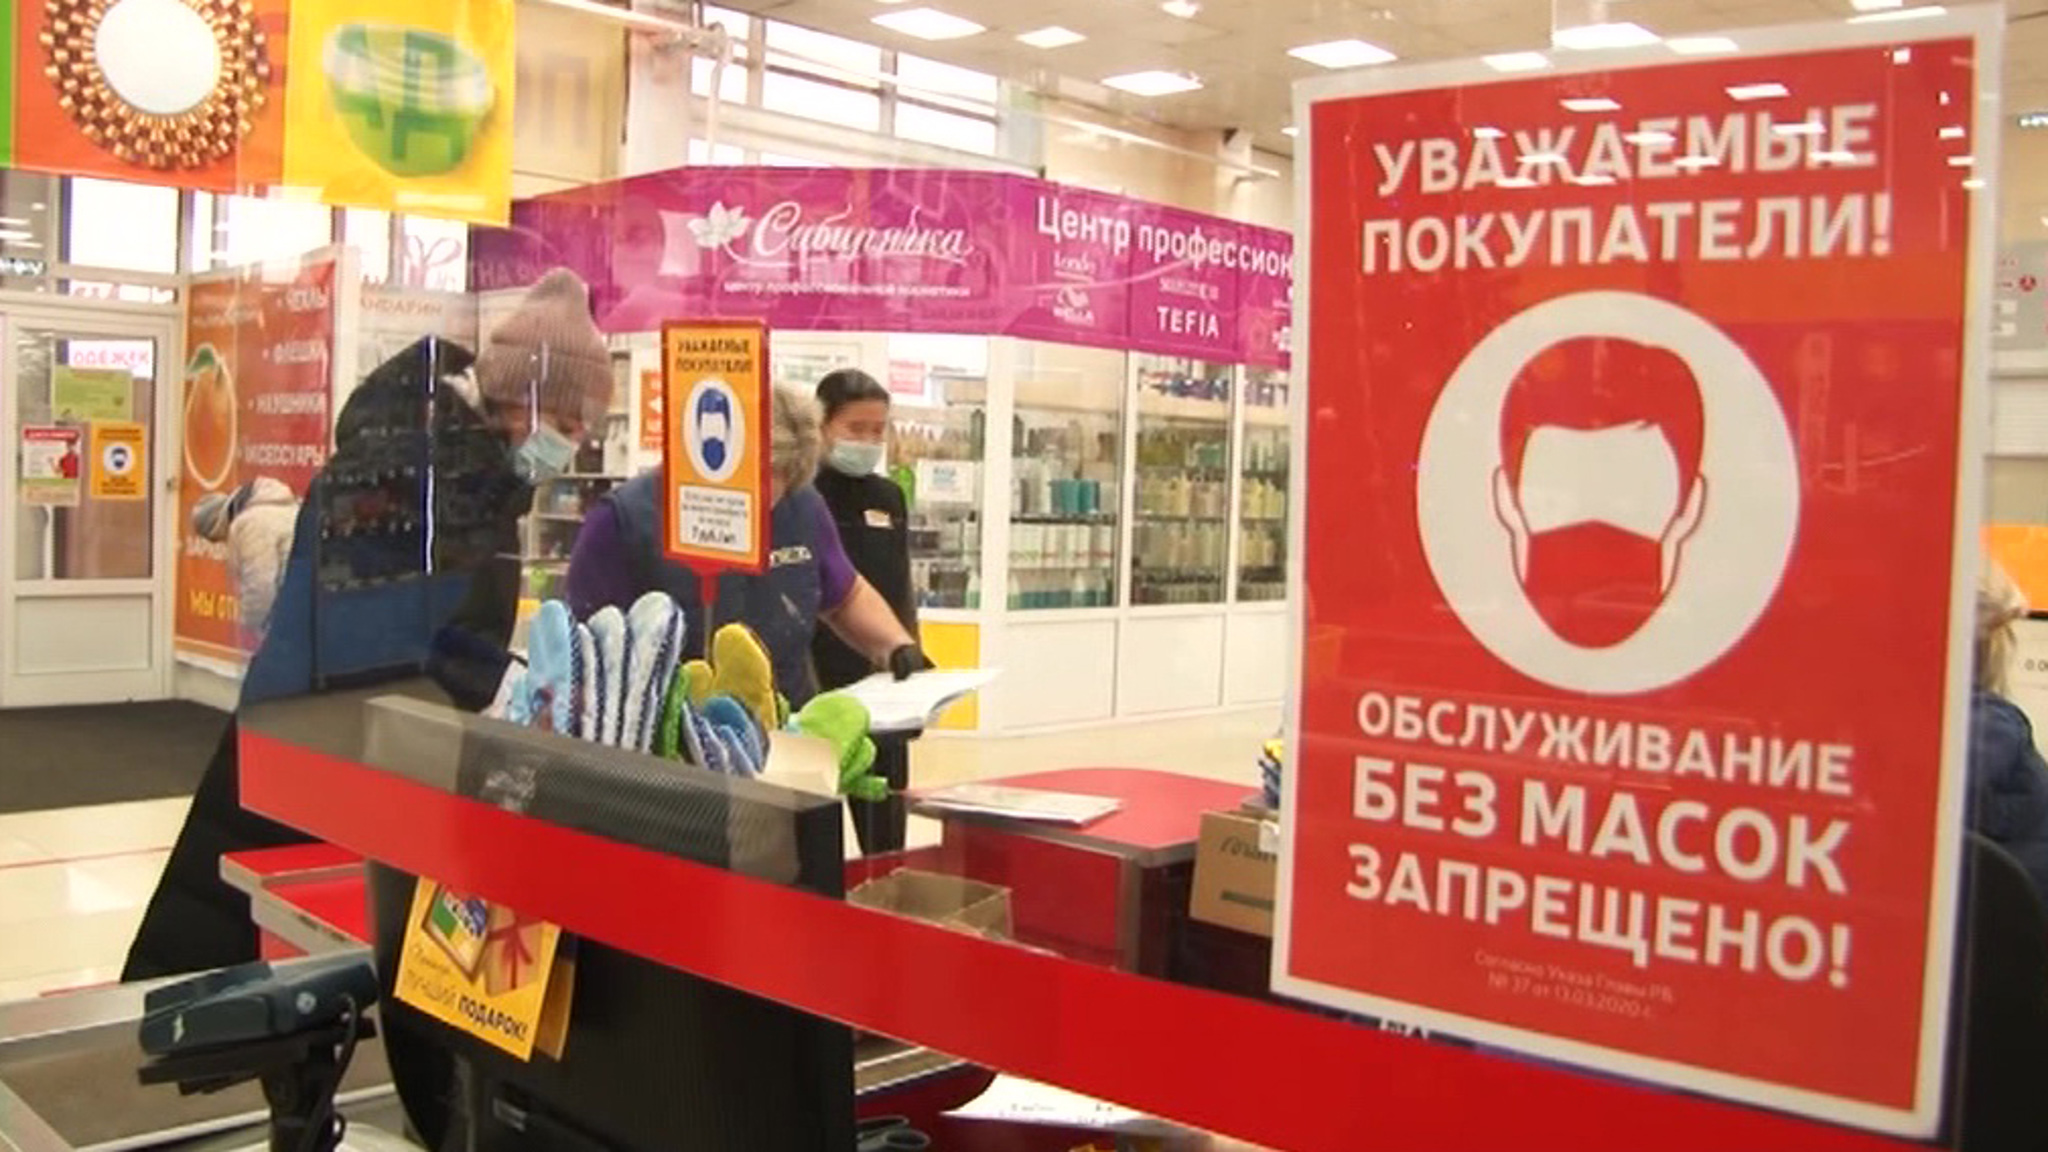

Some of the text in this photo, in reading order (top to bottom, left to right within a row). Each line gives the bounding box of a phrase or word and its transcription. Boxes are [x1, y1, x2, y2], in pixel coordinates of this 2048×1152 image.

[1374, 104, 1879, 198] УВАЖАЕМЫЕ
[1037, 196, 1129, 255] Центр
[1361, 192, 1892, 274] ПОКУПАТЕЛИ!
[1157, 306, 1220, 338] TEFIA
[1357, 691, 1854, 797] ОБСЛУЖИВАНИЕ
[1352, 755, 1852, 896] БЕЗ МАСОК
[1345, 844, 1853, 991] ЗАПРЕЩЕНО!
[1474, 950, 1544, 978] Согласно
[1548, 964, 1593, 988] Указа
[1512, 977, 1531, 993] 37
[1554, 984, 1640, 1018] 13.03.2020
[458, 994, 529, 1042] ПОДАРОК!
